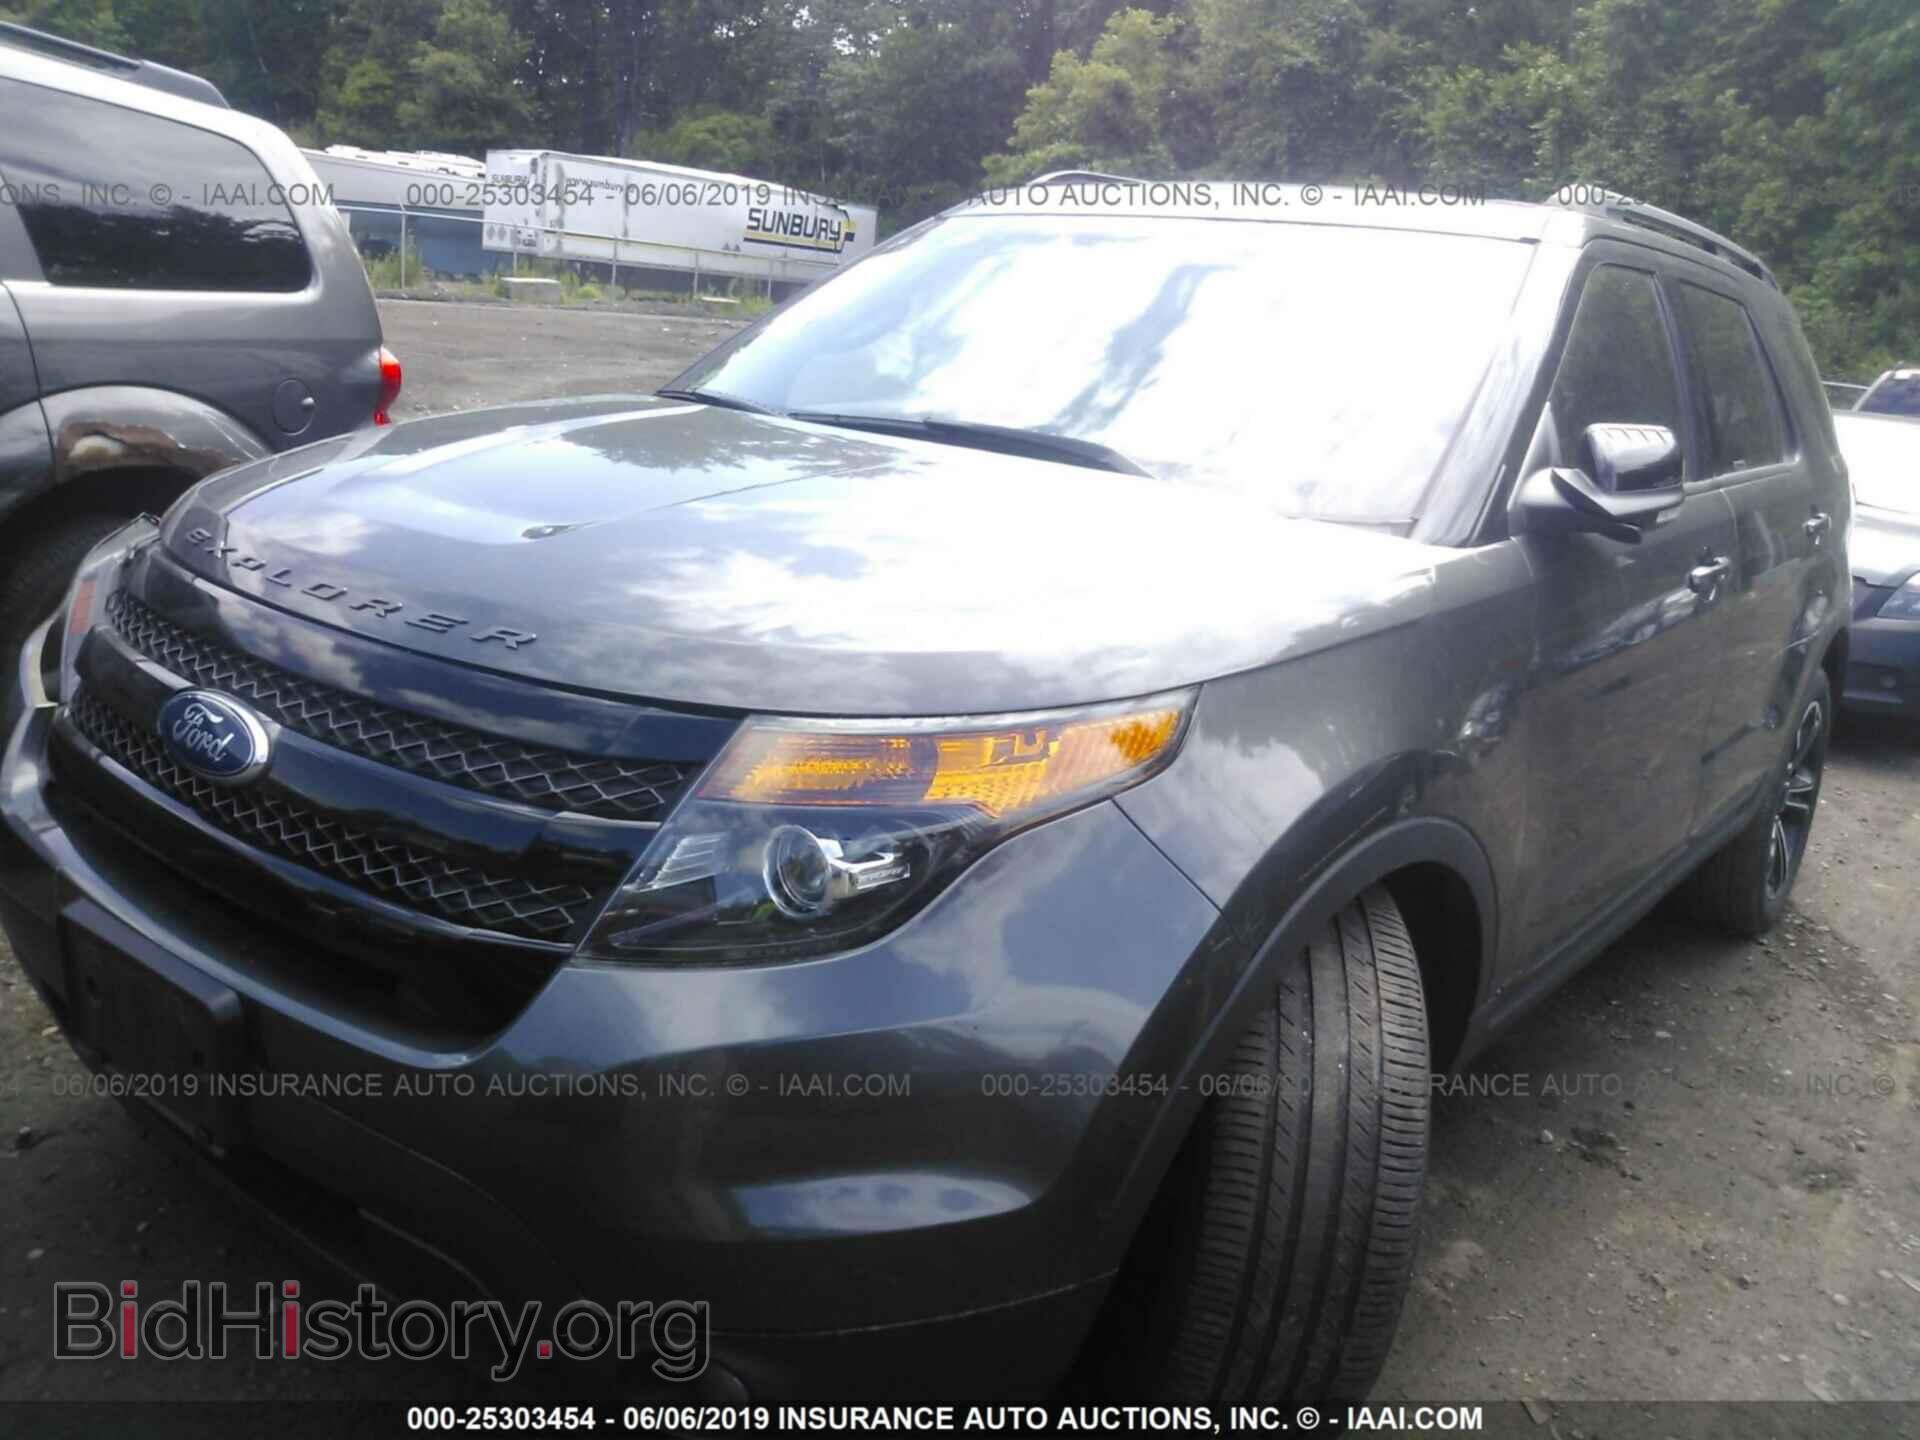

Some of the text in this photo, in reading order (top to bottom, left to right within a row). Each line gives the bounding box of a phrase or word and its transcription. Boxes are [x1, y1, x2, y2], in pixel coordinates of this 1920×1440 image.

[747, 208, 841, 241] SUNBURY
[186, 528, 537, 649] EXPLORER
[173, 702, 235, 762] Ford
